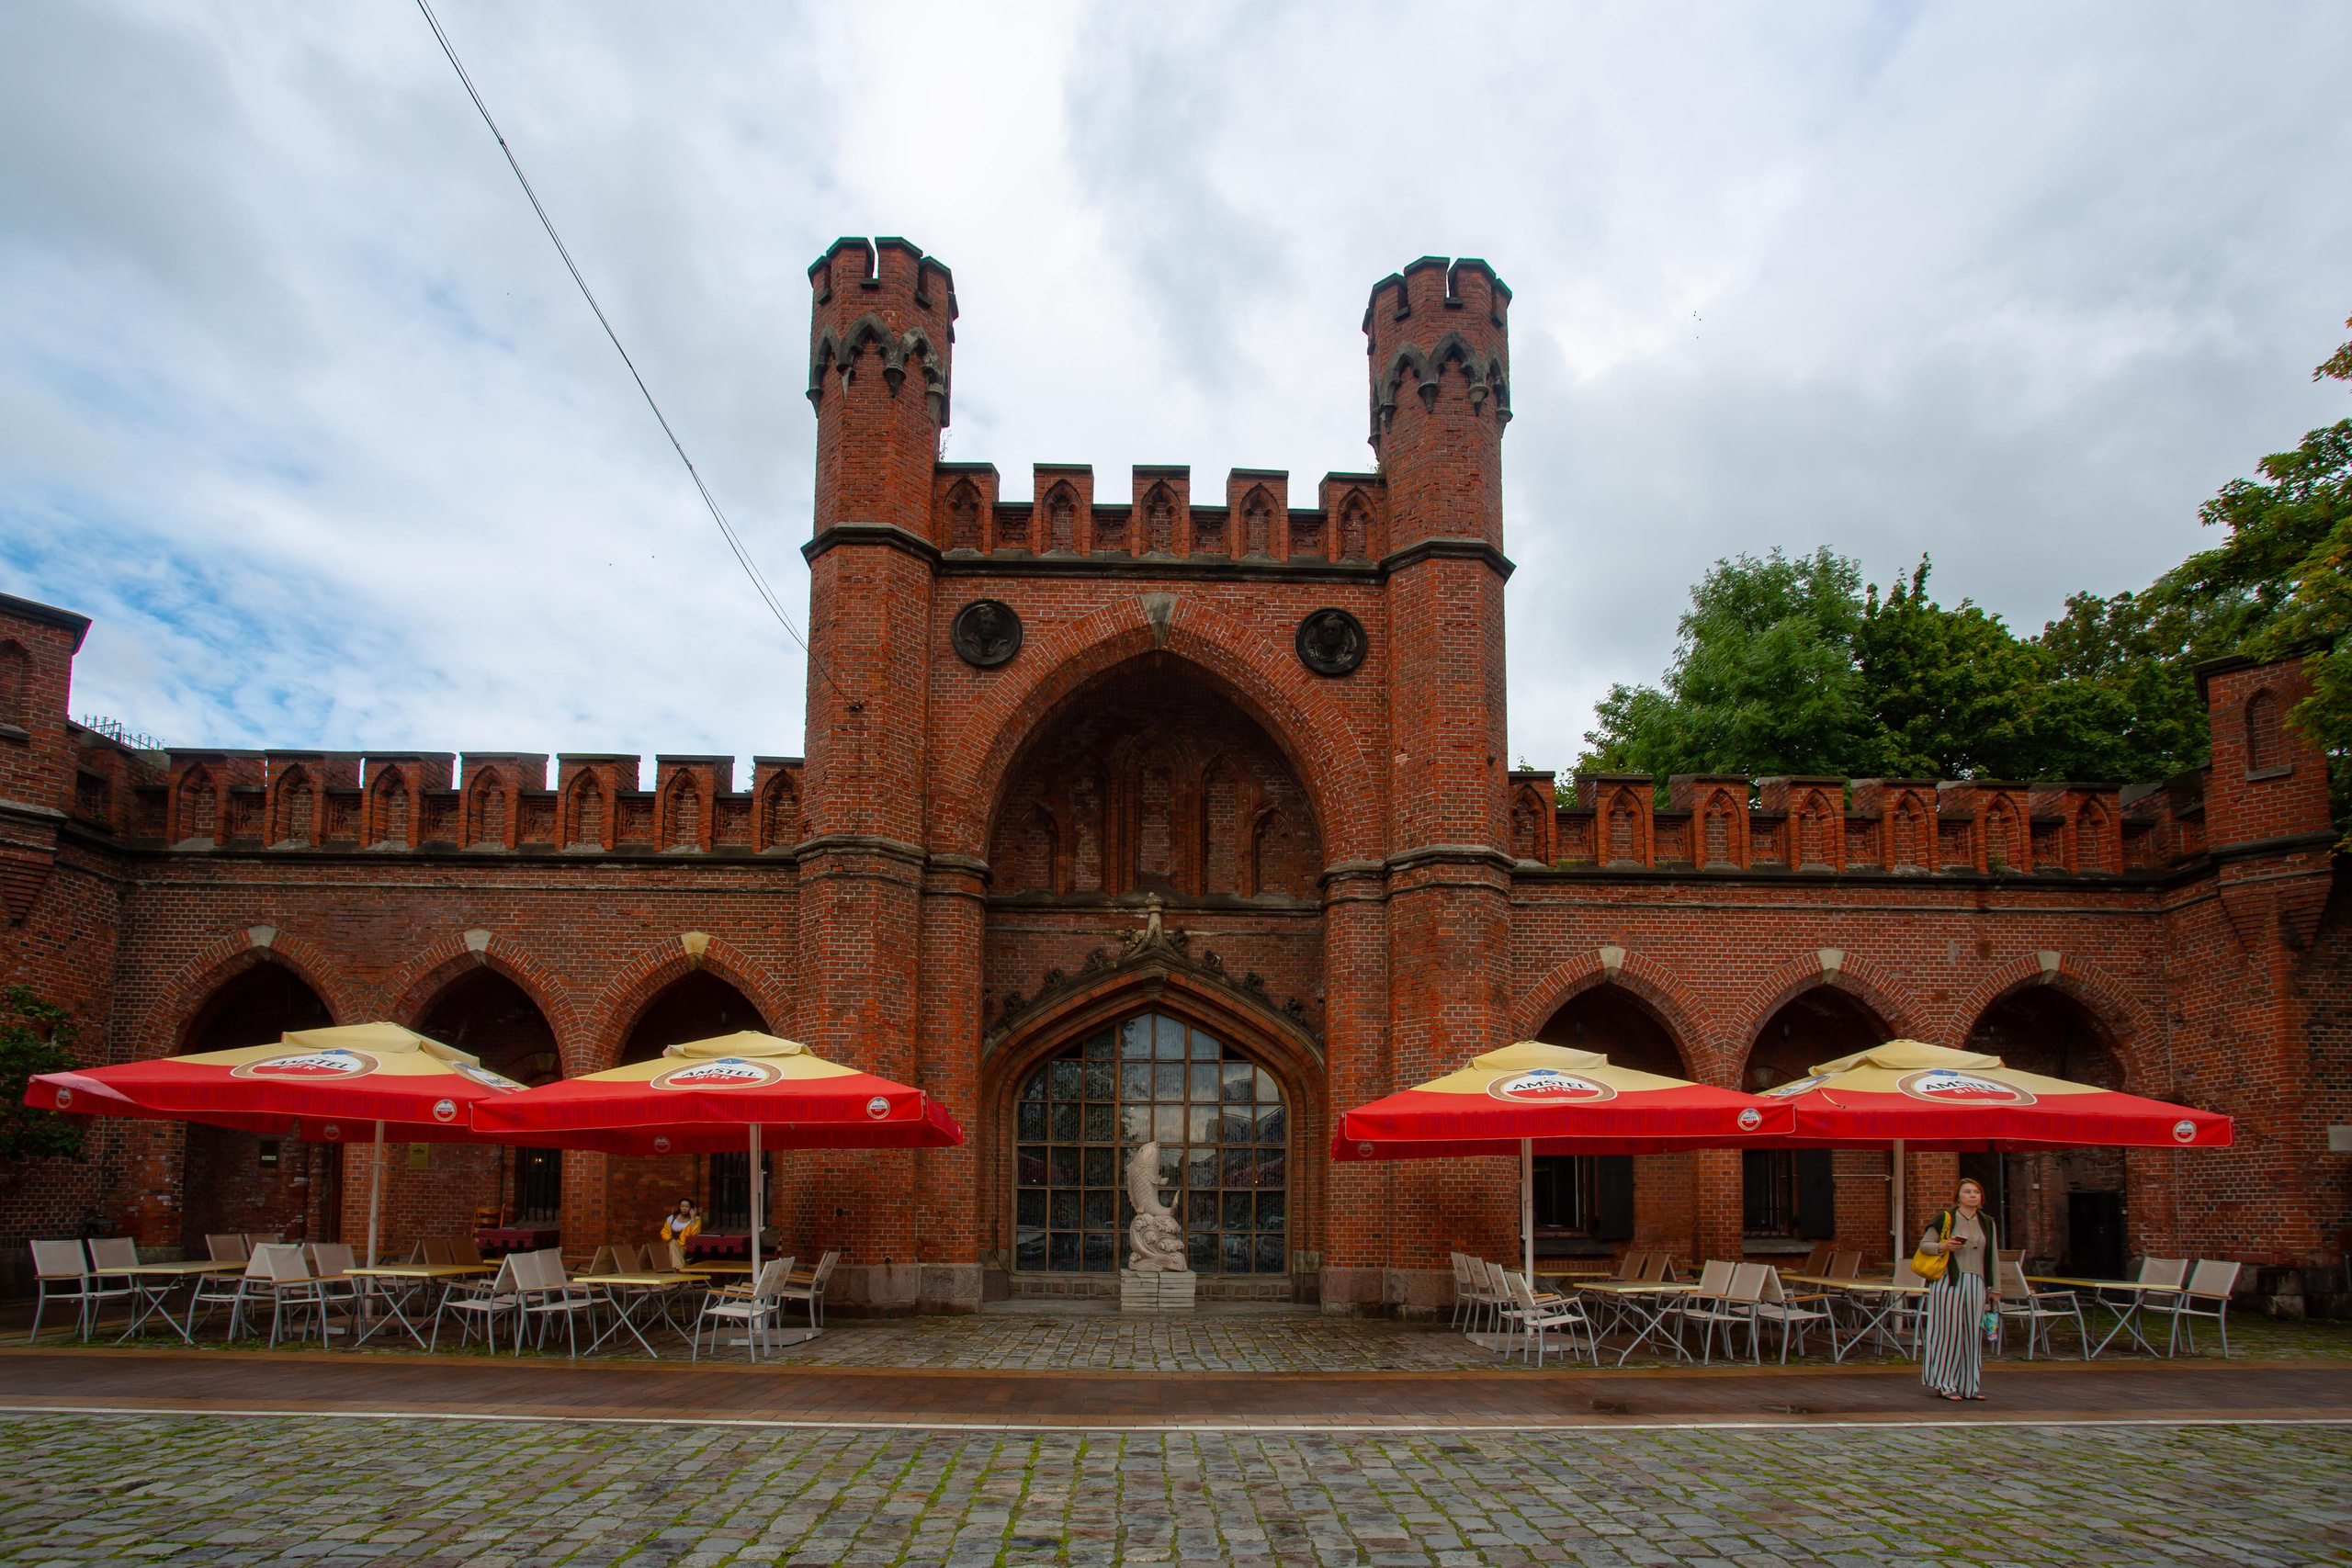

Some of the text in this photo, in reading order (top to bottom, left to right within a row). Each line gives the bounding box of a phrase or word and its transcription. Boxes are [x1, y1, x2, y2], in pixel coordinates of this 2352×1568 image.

[270, 1058, 349, 1069] AMSTEL
[681, 1067, 757, 1077] AMSTEL
[1513, 1079, 1589, 1090] AMSTEL
[1926, 1080, 2003, 1091] AMSTEL
